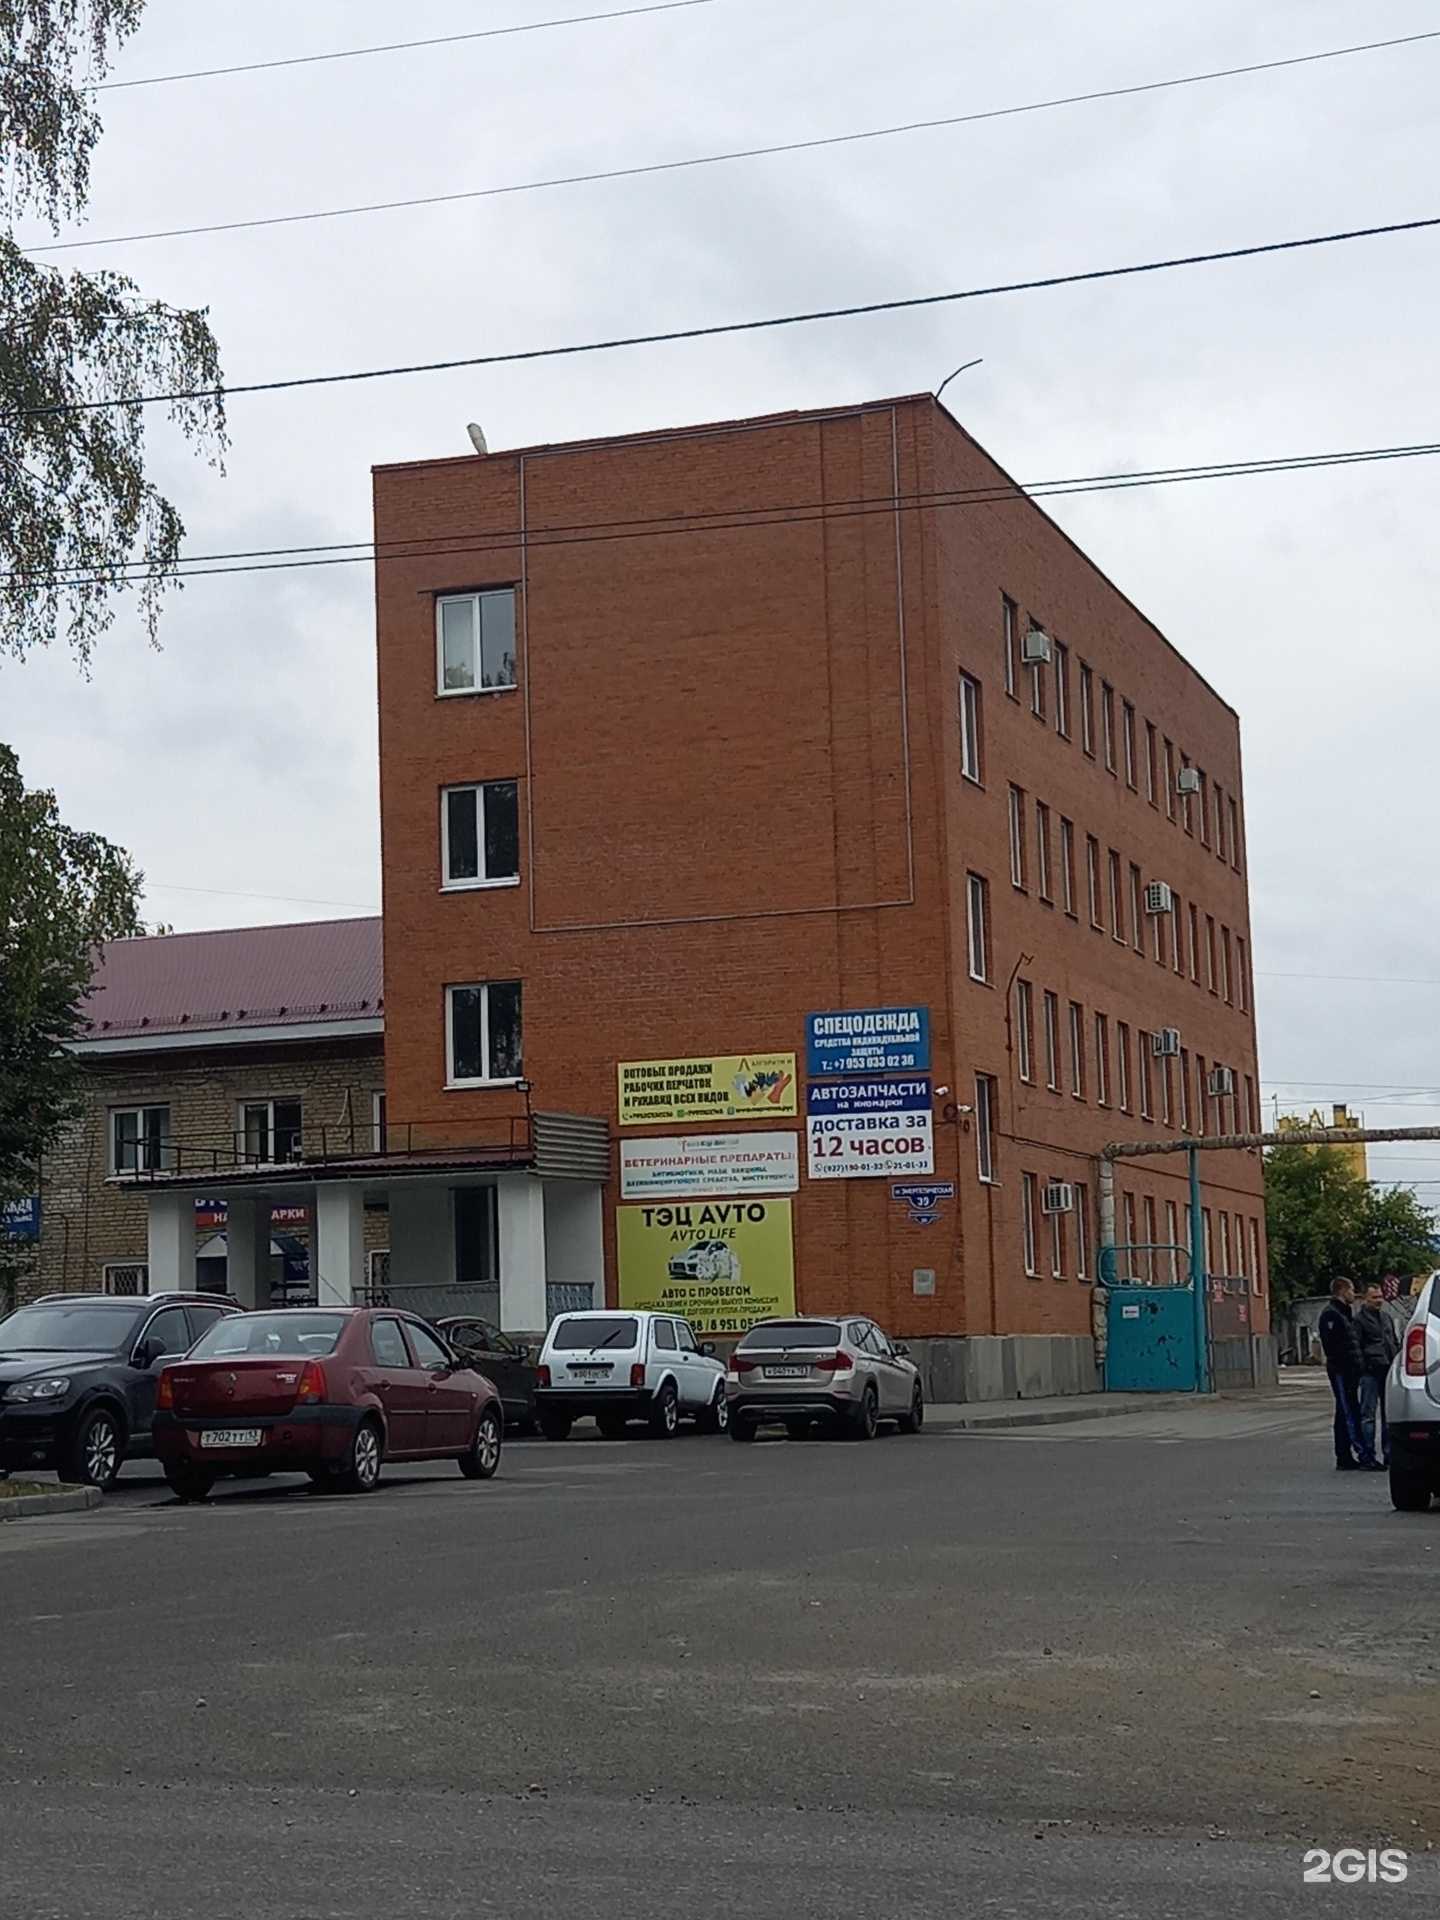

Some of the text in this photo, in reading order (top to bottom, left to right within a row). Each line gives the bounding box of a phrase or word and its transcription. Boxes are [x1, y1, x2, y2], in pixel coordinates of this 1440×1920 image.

[813, 1012, 919, 1035] СПЕЦОДЕЖДА
[668, 1063, 712, 1076] ПРОДАЖИ
[624, 1078, 711, 1093] РАБОЧИХ ПЕРЧАТОК
[811, 1082, 926, 1100] АВТОЗАПЧАСТИ
[674, 1093, 696, 1104] ВСЕХ
[697, 1091, 729, 1104] ВИДОВ
[906, 1115, 927, 1128] за
[813, 1136, 925, 1157] 12 часов
[624, 1154, 717, 1168] ВЕТЕРИНАРНЫЕ
[641, 1203, 766, 1227] ТЭЦ AVTO
[669, 1227, 737, 1242] AVTO LIFE
[661, 1286, 751, 1299] АВТО С ПРОБЕГОМ
